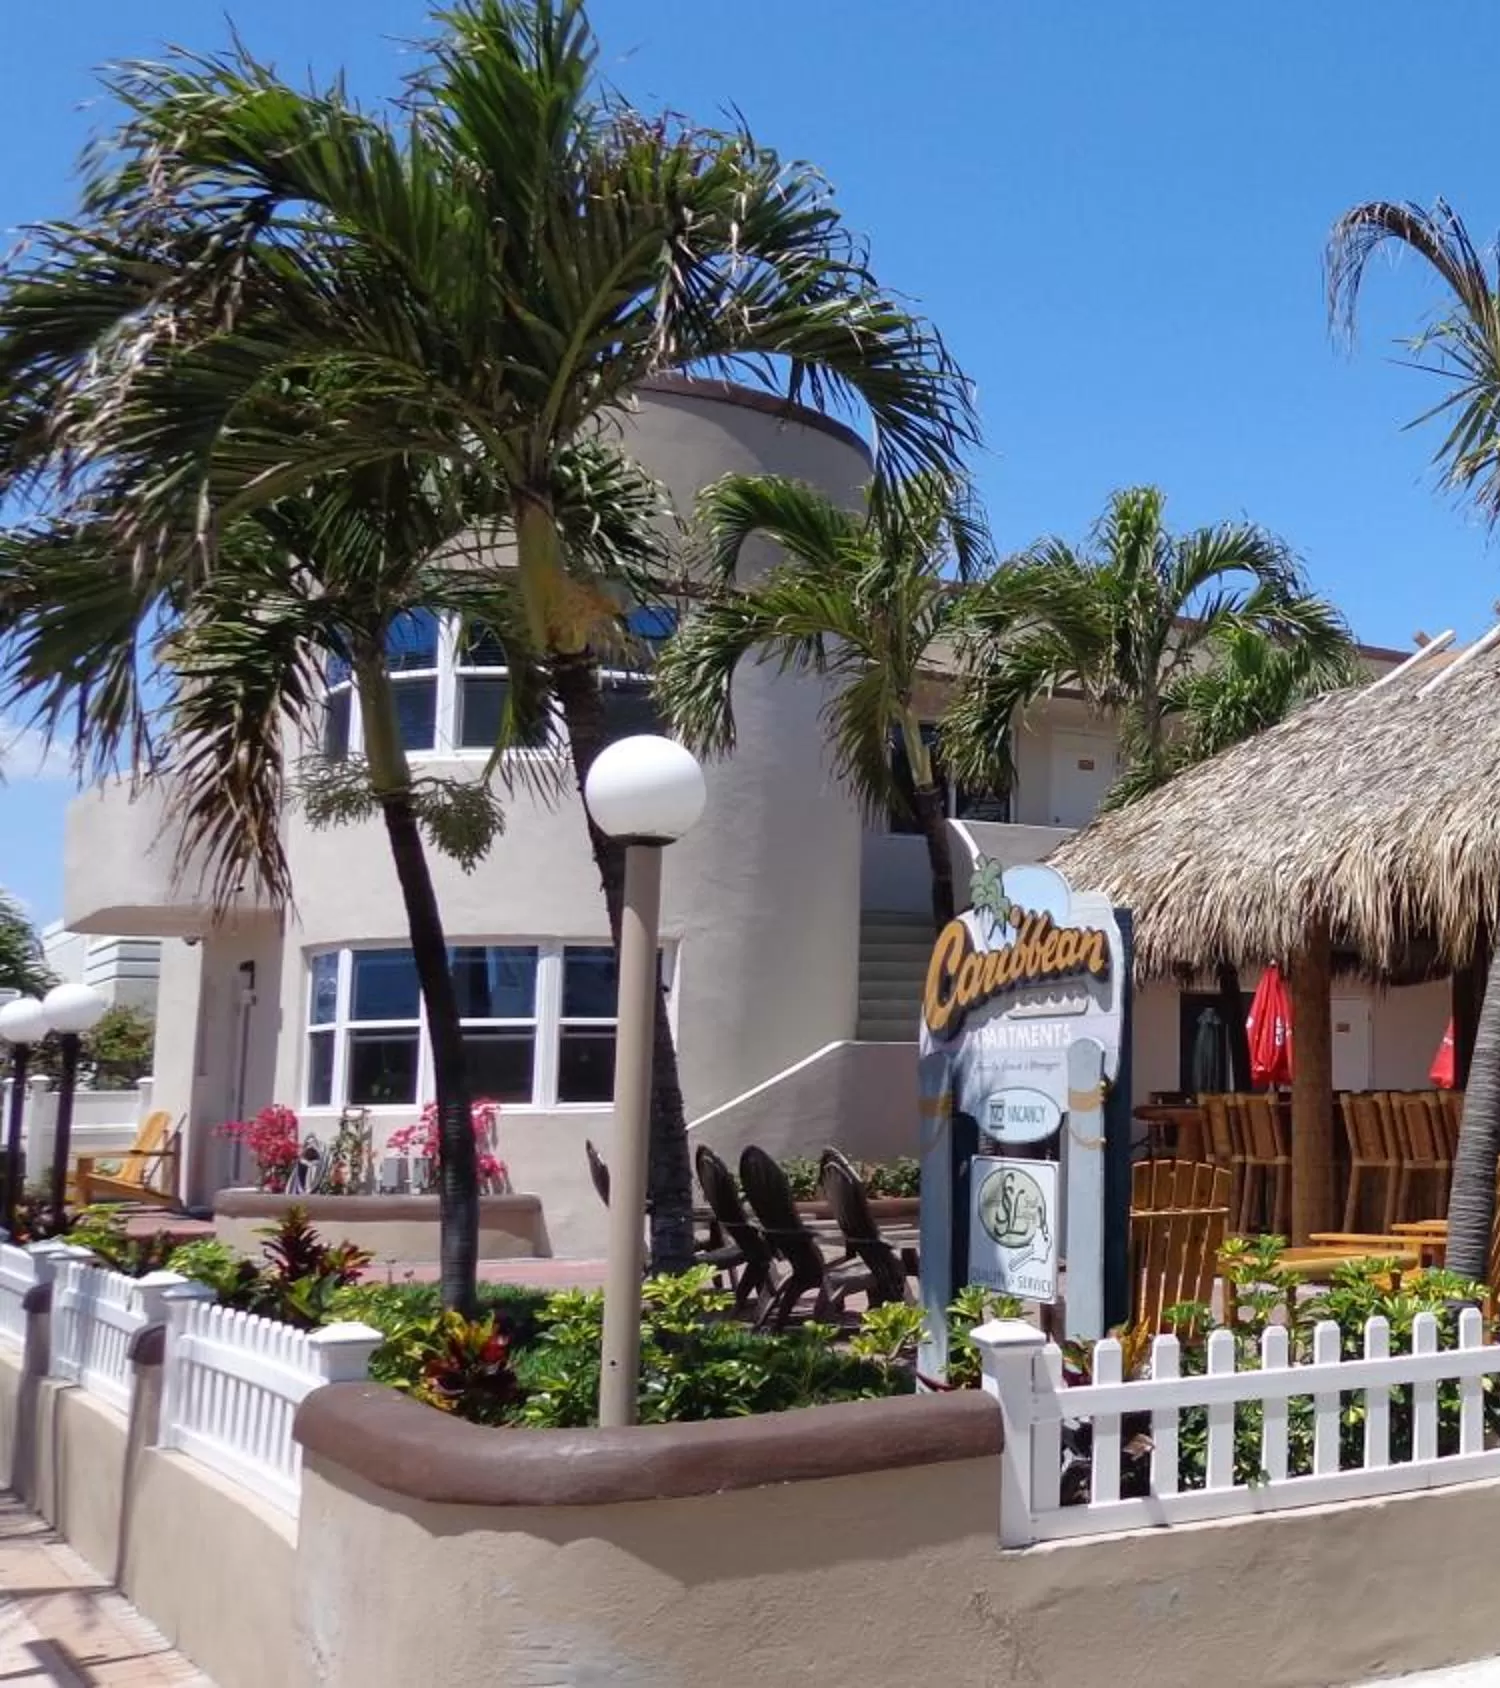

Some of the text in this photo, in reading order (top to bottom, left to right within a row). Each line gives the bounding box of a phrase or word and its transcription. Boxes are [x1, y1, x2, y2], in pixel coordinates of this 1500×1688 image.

[925, 906, 1105, 1031] Caribbean
[972, 1023, 1071, 1050] APARTMENTS
[1006, 1104, 1046, 1124] VACANCY
